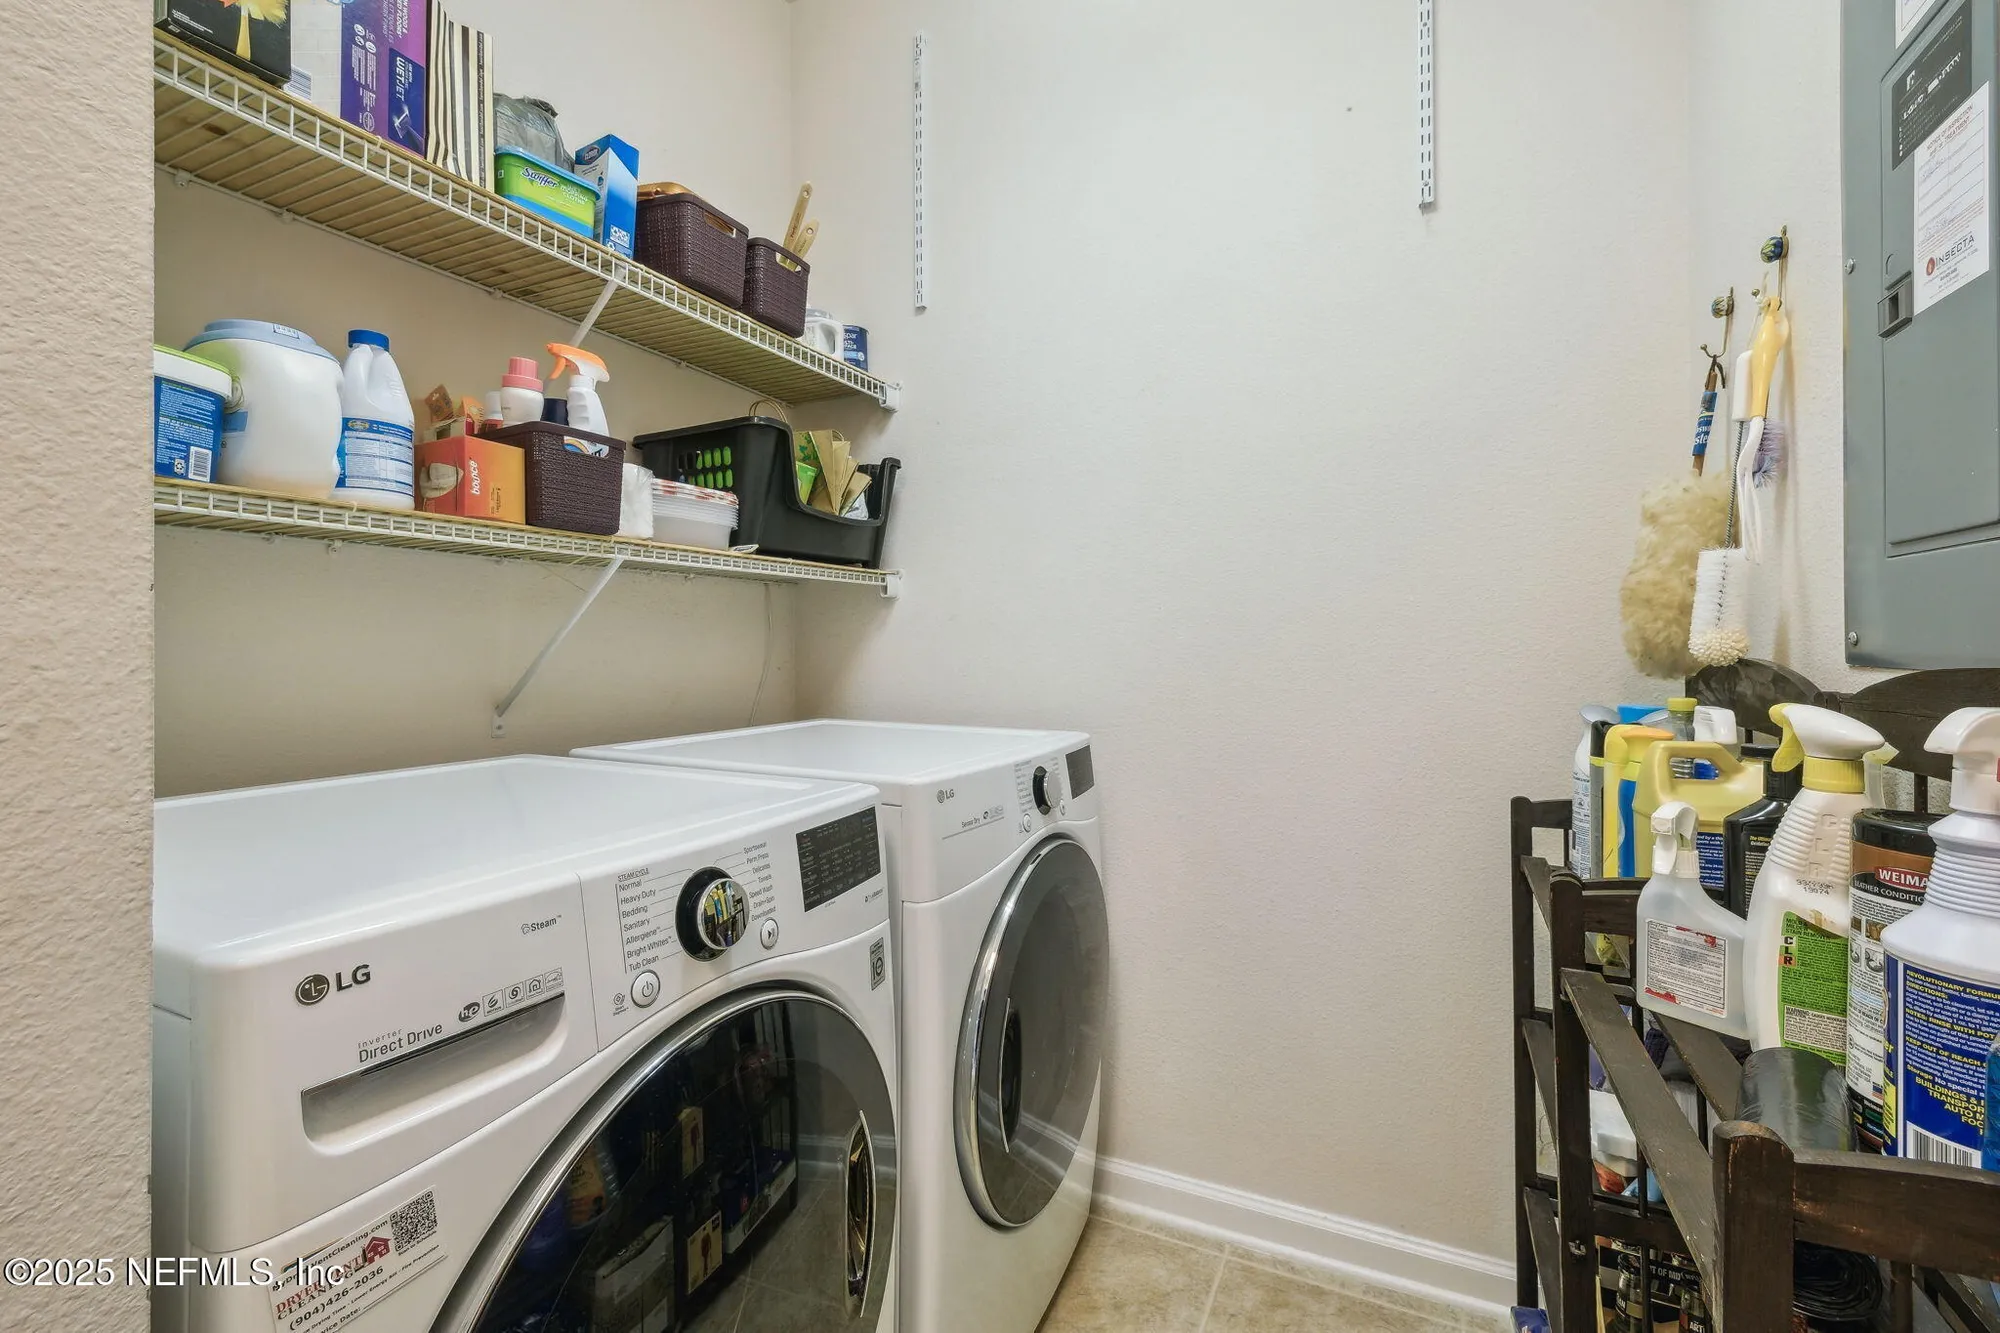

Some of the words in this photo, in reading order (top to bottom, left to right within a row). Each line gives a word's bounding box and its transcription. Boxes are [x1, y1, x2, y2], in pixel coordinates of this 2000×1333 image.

[396, 56, 404, 102] WETJET
[522, 166, 558, 188] Swiffer
[1936, 234, 1974, 267] INSECTA
[470, 460, 480, 495] bounce
[946, 789, 954, 800] LG
[617, 872, 635, 882] STEAM
[635, 868, 649, 878] CYCLE
[619, 879, 642, 892] Normal
[1854, 880, 1879, 894] LEATHER
[620, 894, 642, 906] Heavy
[642, 888, 656, 900] Duty
[622, 904, 648, 918] Bedding
[624, 918, 650, 932] Sanitary
[626, 946, 647, 958] Bright
[628, 962, 641, 972] Tub
[642, 955, 659, 968] Clean
[335, 964, 370, 992] LG
[1906, 970, 1964, 992] REVOLUTIONARY
[1906, 980, 1948, 999] DIRECTIONS:
[1929, 1016, 1951, 1028] RINSE
[1953, 1024, 1974, 1034] WITH
[358, 1028, 402, 1050] Inverter
[358, 1038, 403, 1064] Direct
[408, 1024, 443, 1046] Drive
[1906, 1036, 1921, 1046] KEEP
[1922, 1043, 1937, 1052] OUT
[1939, 1049, 1949, 1057] OF
[1952, 1052, 1980, 1068] REACH
[1916, 1076, 1967, 1102] BUILDINGS
[1970, 1096, 1978, 1104] &
[1934, 1076, 1946, 1086] No
[1948, 1081, 1977, 1096] special
[1944, 1103, 1973, 1118] AUTO
[311, 1314, 331, 1329] Drying
[332, 1305, 346, 1316] Time
[351, 1291, 368, 1304] Lower
[369, 1278, 388, 1292] Energy
[413, 1244, 440, 1263] Prevention
[290, 1266, 384, 1331] (904)426-2036
[340, 1306, 360, 1323] Date:
